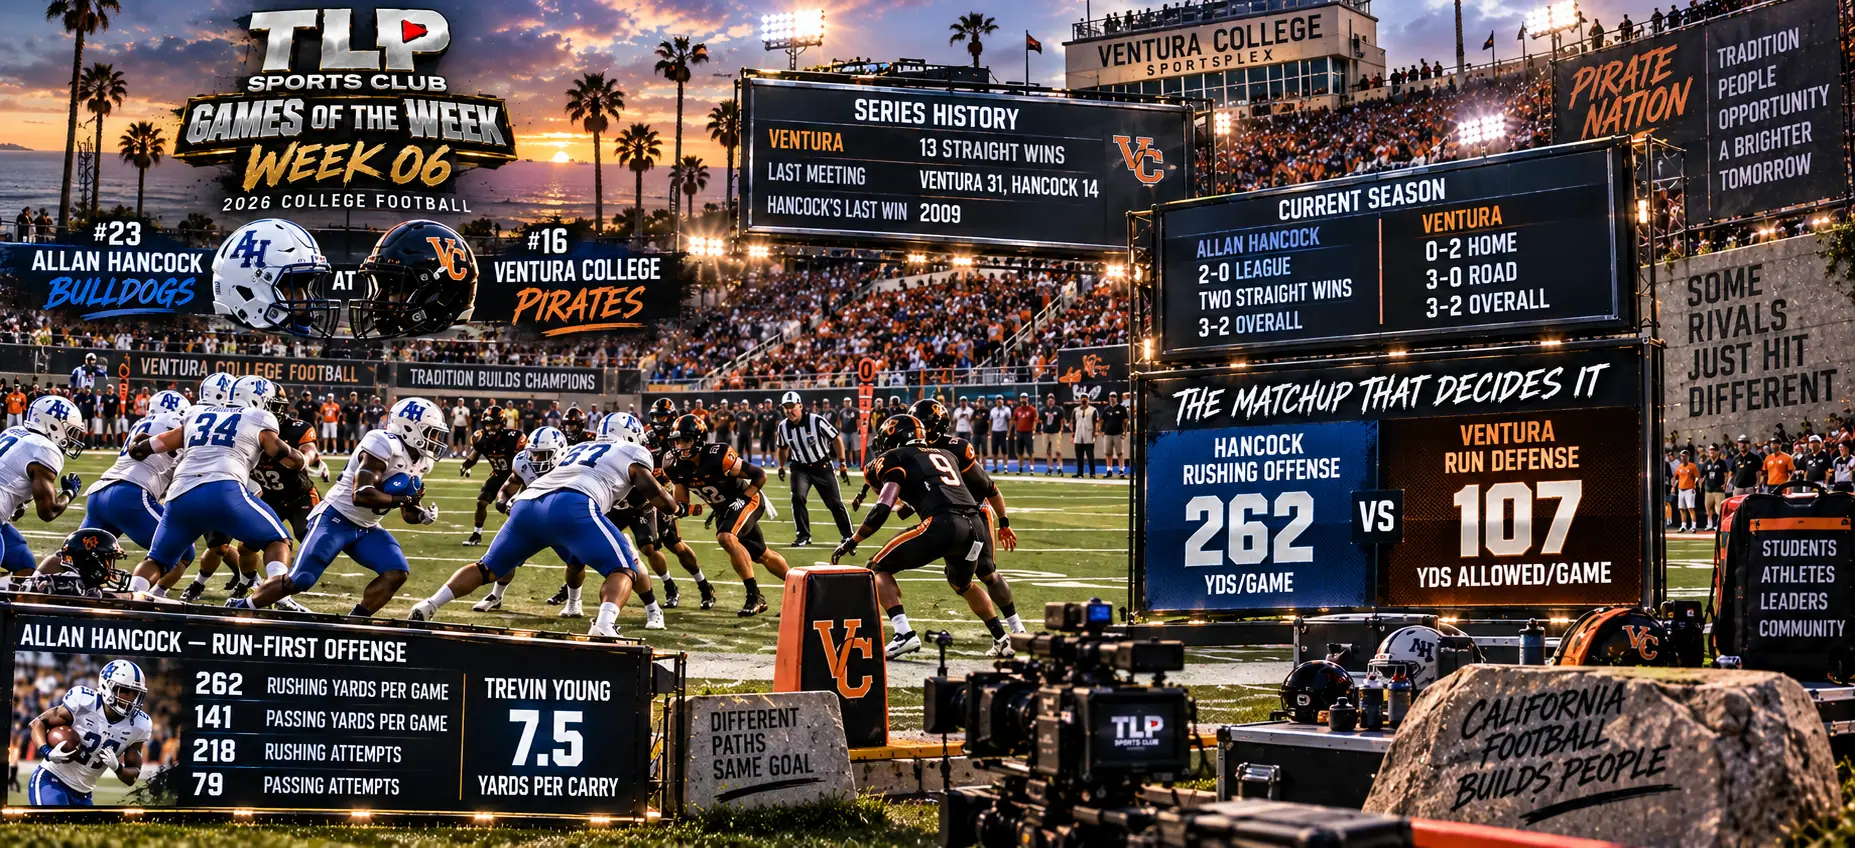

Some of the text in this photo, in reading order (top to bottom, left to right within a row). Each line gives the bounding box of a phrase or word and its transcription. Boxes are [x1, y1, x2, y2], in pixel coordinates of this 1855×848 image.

[1098, 14, 1323, 67] VENTURA COLLEGE
[1717, 27, 1799, 68] TRADITION
[1146, 49, 1273, 76] SPORTSPLEX
[1569, 44, 1681, 110] PIRATE
[1719, 65, 1776, 99] PEOPLE
[855, 99, 1019, 130] SERIES HISTORY
[1581, 76, 1693, 139] NATION
[1719, 84, 1829, 130] OPPORTUNITY
[769, 129, 843, 152] VENTURA
[920, 138, 1064, 164] 13 STRAIGHT WINS
[1719, 121, 1812, 161] A BRIGHTER
[1113, 135, 1164, 183] VC
[1719, 153, 1811, 191] TOMORROW
[769, 162, 865, 185] LAST MEETING
[920, 170, 1099, 198] VENTURA 31, HANCOCK 14
[768, 196, 907, 220] HANCOCK'S LAST WIN
[1279, 178, 1446, 220] CURRENT SEASON
[920, 203, 960, 223] 2009
[1422, 206, 1502, 233] VENTURA
[1197, 227, 1320, 258] ALLAN HANCOCK
[1426, 232, 1517, 261] 0-2 HOME
[1199, 257, 1291, 284] 2-0 LEAGUE
[1426, 262, 1517, 289] 3-0 ROAD
[1199, 279, 1352, 310] TWO STRAIGHT WINS
[1688, 263, 1762, 307] SOME
[1427, 288, 1550, 318] 3-2 OVERALL
[1199, 311, 1302, 337] 3-2 OVERALL
[1688, 299, 1786, 344] RIVALS
[140, 357, 358, 382] VENTURA COLLEGE FOOTBALL
[1688, 334, 1808, 380] JUST HIT
[411, 368, 595, 391] TRADITION BUILDS CHAMPIONS
[1689, 369, 1837, 417] DIFFERENT
[1173, 363, 1610, 427] THE MATCHUP THAT DECIDES IT
[399, 400, 426, 422] AH
[188, 413, 241, 448] 34
[1461, 420, 1555, 446] VENTURA
[1215, 433, 1304, 458] HANCOCK
[929, 454, 962, 486] 9
[1184, 457, 1340, 485] RUSHING OFFENSE
[1445, 446, 1579, 474] RUN DEFENSE
[1185, 491, 1314, 567] 262
[1359, 500, 1394, 532] VS
[1454, 480, 1582, 557] 107
[1763, 540, 1836, 556] STUDENTS
[1205, 572, 1293, 595] YDS/GAME
[1417, 562, 1611, 587] YDS ALLOWED/GAME
[1761, 566, 1835, 583] ATHLETES
[1761, 592, 1827, 610] LEADERS
[1760, 620, 1845, 637] COMMUNITY
[21, 624, 84, 648] ALLAN
[91, 628, 182, 652] HANCOCK
[213, 633, 318, 658] RUN-FIRST
[325, 639, 406, 662] OFFENSE
[1622, 624, 1659, 661] VC
[812, 619, 873, 699] VC
[196, 671, 242, 695] 262
[268, 677, 449, 700] RUSHING YARDS PER GAME
[485, 678, 610, 701] TREVIN YOUNG
[195, 705, 231, 728] 141
[267, 710, 447, 731] PASSING YARDS PER GAME
[711, 708, 799, 732] DIFFERENT
[1461, 684, 1626, 740] CALIFORNIA
[509, 709, 583, 766] 7.5
[1112, 716, 1163, 738] TLP
[193, 739, 235, 762] 218
[265, 743, 401, 762] RUSHING ATTEMPTS
[713, 731, 767, 756] PATHS
[1480, 721, 1610, 766] FOOTBALL
[714, 754, 814, 780] SAME GOAL
[1451, 745, 1672, 813] BUILDS PEOPLE
[193, 772, 223, 795] 79
[264, 776, 399, 795] PASSING ATTEMPTS
[478, 775, 618, 796] YARDS PER CARRY
